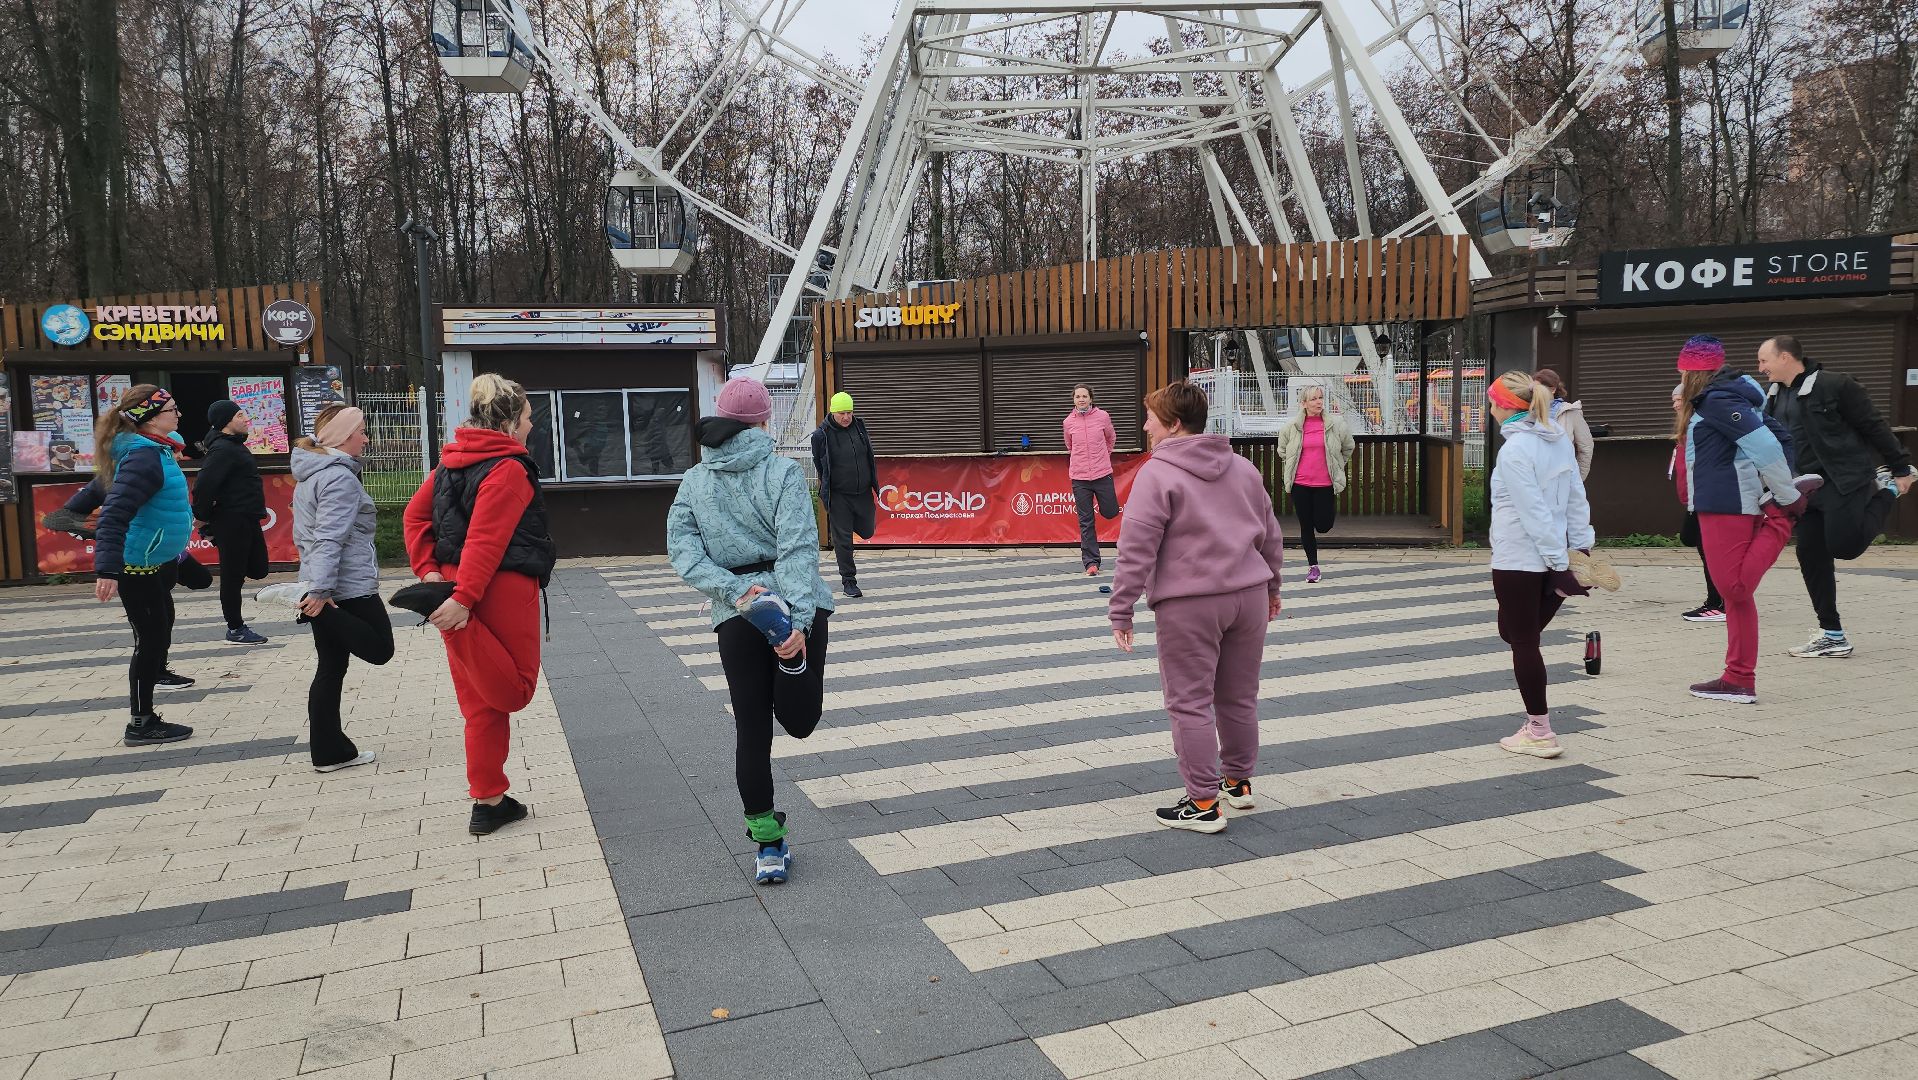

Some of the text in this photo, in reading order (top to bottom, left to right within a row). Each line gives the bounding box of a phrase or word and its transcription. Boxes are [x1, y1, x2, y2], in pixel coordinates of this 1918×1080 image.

[1622, 251, 1870, 292] КОФЕ STORE
[96, 305, 218, 322] КРЕВЕТКИ
[267, 310, 308, 322] КОФЕ
[854, 301, 961, 329] SUBWAY
[93, 323, 225, 344] СЭНДВИЧИ
[1035, 492, 1076, 503] ПАРКИ
